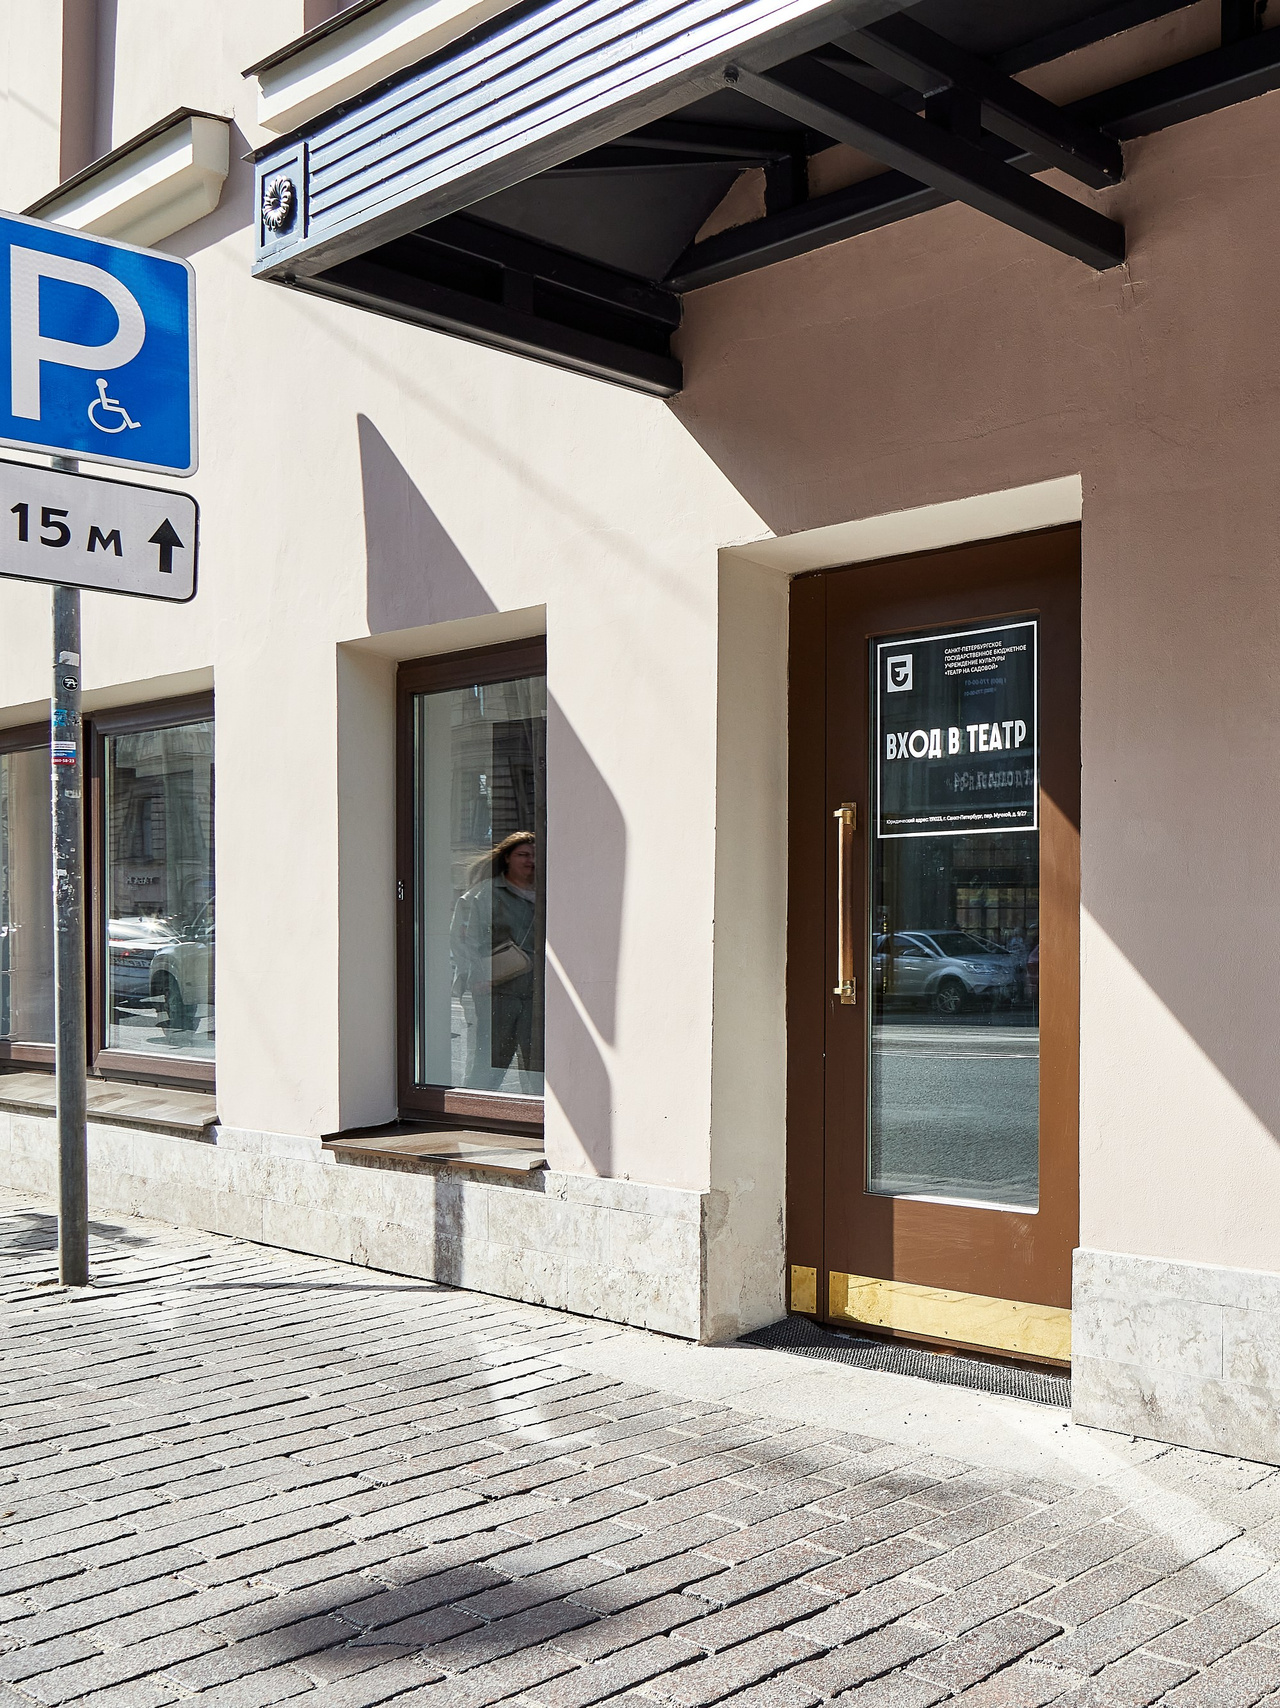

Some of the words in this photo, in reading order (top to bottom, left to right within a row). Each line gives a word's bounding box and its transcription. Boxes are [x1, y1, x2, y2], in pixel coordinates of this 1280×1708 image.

[10, 501, 72, 549] 15
[944, 641, 1002, 655] САНКТ-ПЕТЕРБУРГСКОЕ
[944, 650, 993, 662] ГОСУДАРСТВЕННОЕ
[993, 644, 1027, 655] БЮДЖЕТНОЕ
[944, 659, 978, 669] УЧРЕЖДЕНИЕ
[978, 655, 1006, 665] КУЛЬТУРЫ
[886, 728, 942, 760] ВХОД
[948, 726, 960, 755] В
[966, 720, 1027, 753] ТЕАТР
